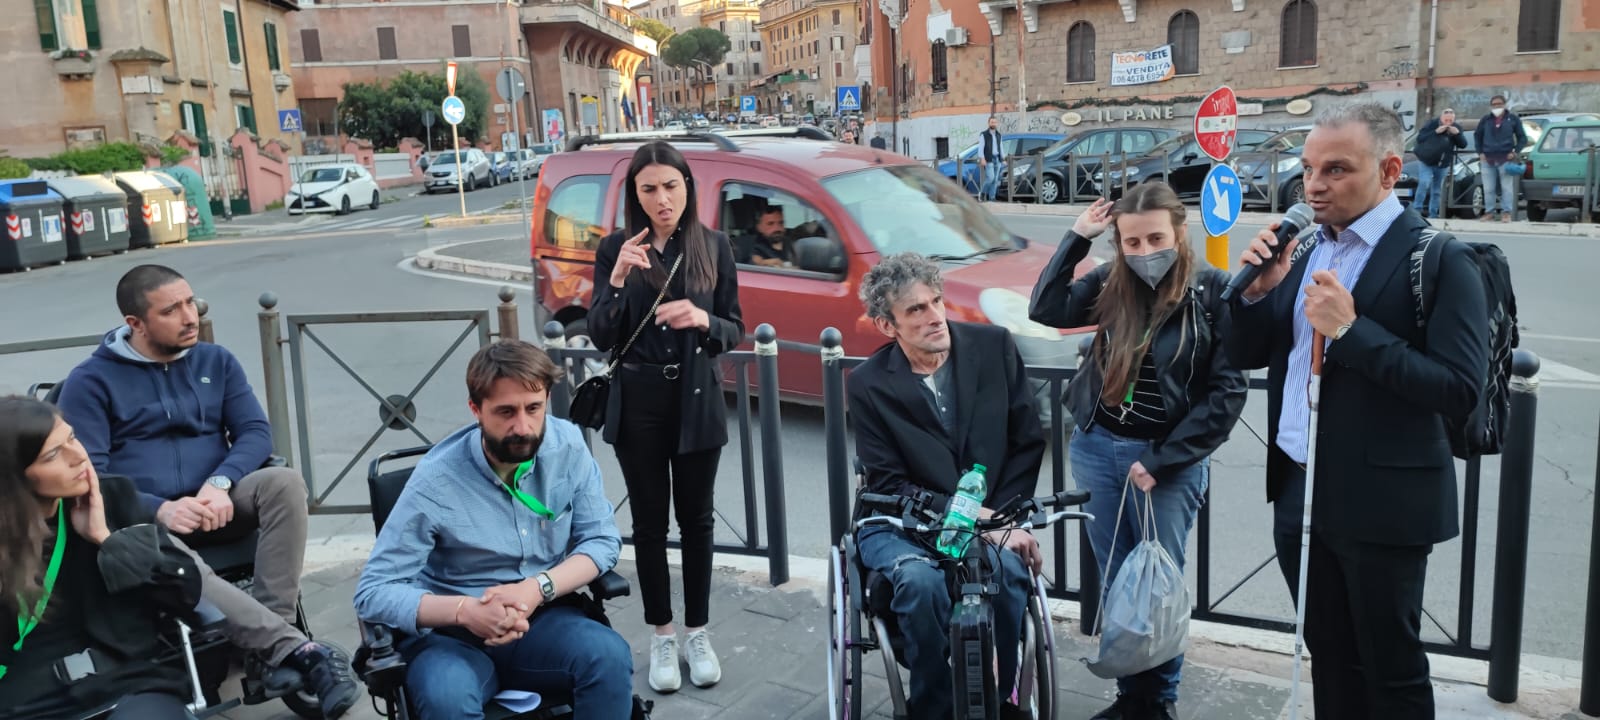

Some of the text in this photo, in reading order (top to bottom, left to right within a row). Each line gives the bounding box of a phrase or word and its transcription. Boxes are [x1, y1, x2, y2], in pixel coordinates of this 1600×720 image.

[1116, 48, 1168, 64] TECNORETE
[1126, 62, 1170, 75] VENDITA
[743, 97, 753, 110] P
[1098, 106, 1174, 122] IL PANE
